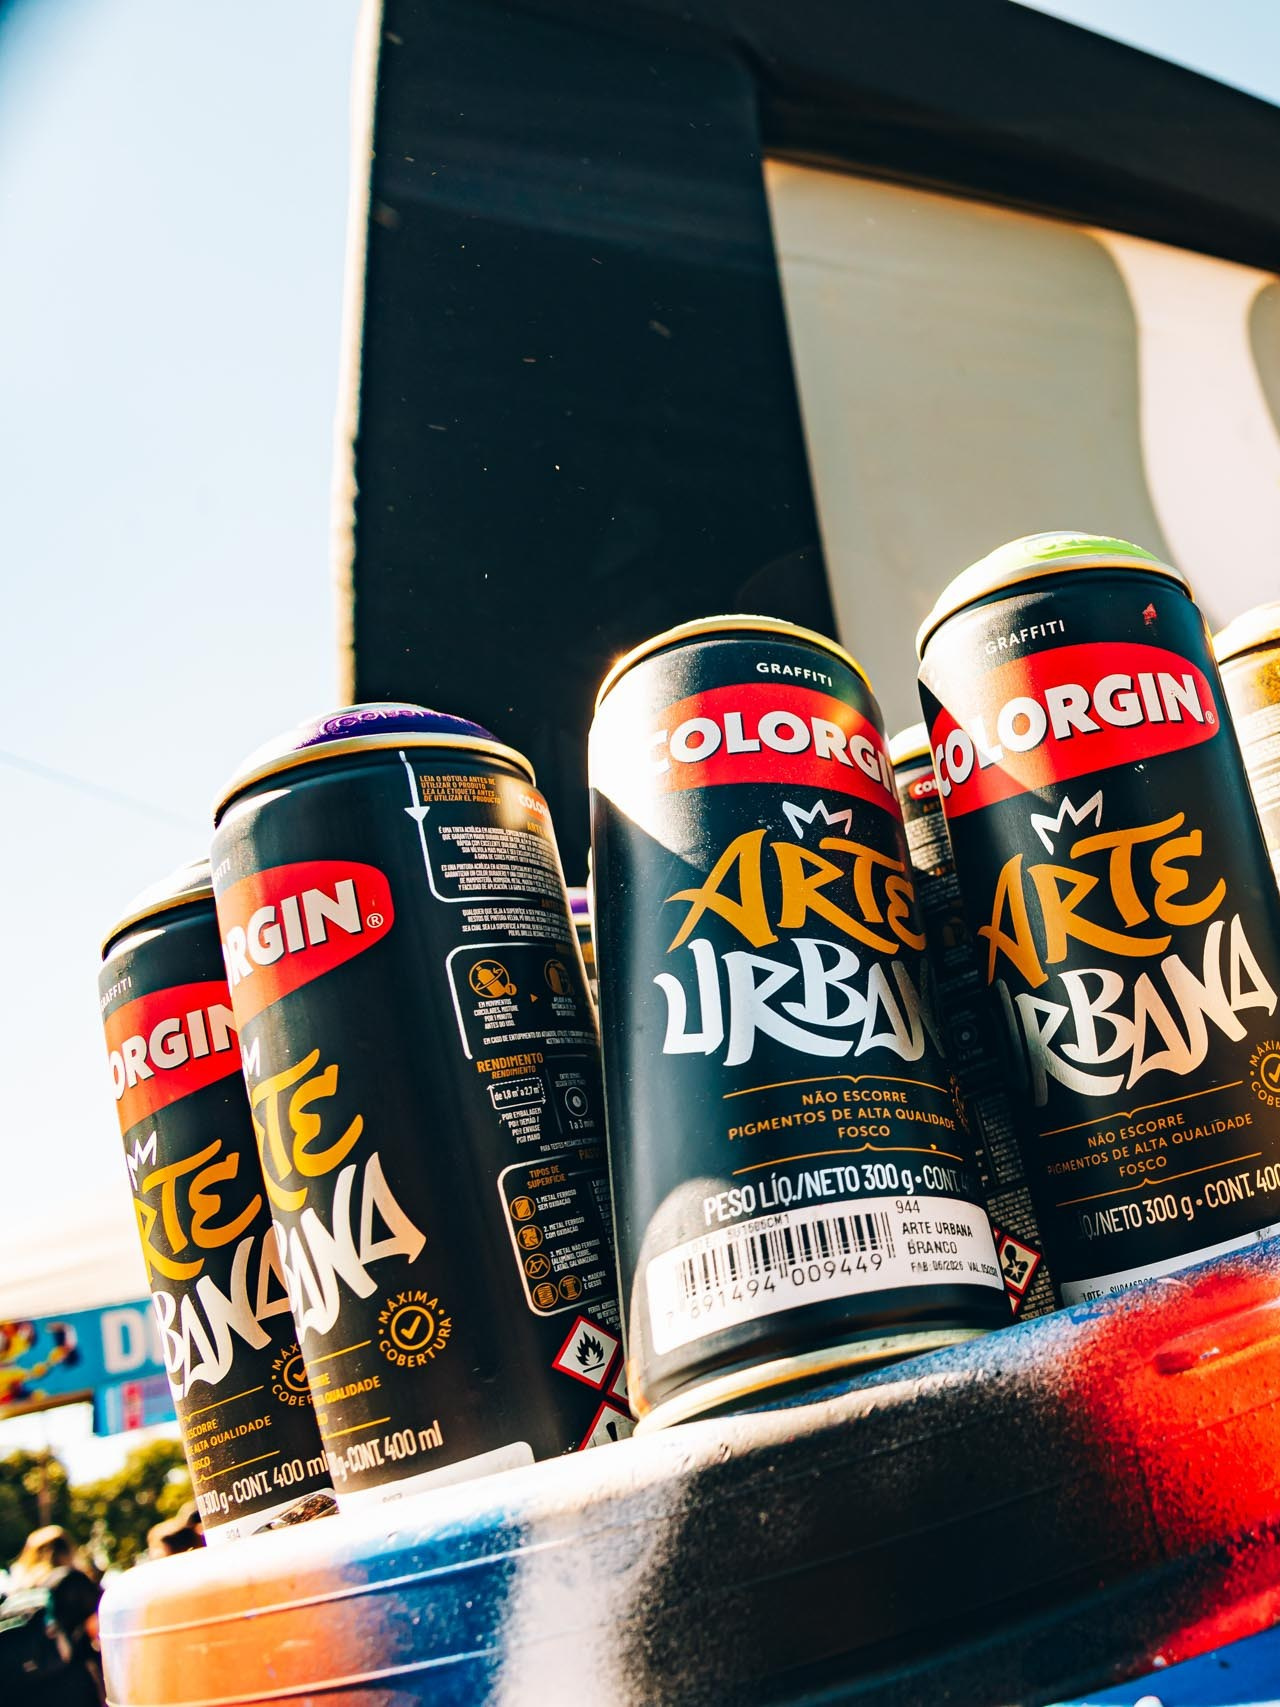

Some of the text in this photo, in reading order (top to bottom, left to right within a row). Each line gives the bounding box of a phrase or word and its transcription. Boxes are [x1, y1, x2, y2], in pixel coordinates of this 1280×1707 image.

[985, 619, 1065, 656] GRAFFITI
[756, 661, 833, 688] GRAFFITI
[934, 672, 1205, 797] COLORGIN
[650, 710, 898, 798] COLORGI
[664, 829, 927, 955] ARTE
[977, 811, 1226, 989] ARTE
[223, 878, 362, 993] RGIN
[1002, 913, 1279, 1105] RBANA
[476, 1052, 544, 1073] RENDIMENTO
[491, 1065, 537, 1080] RENDIMIENTO
[494, 1091, 503, 1101] de
[520, 1089, 525, 1097] a
[802, 1090, 908, 1106] NÃO ESCORRE
[728, 1107, 956, 1141] PIGMENTOS DE ALTA QUALIDADE
[838, 1125, 890, 1139] FOSCO
[1088, 1114, 1185, 1148] NÃO ESCORRE
[1112, 1148, 1130, 1161] DE
[1135, 1137, 1168, 1156] ALTA
[1171, 1113, 1253, 1146] QUALIDADE
[529, 1164, 560, 1178] TIPOS DE
[1119, 1155, 1167, 1178] FOSCO
[703, 1184, 756, 1226] PESO
[760, 1165, 860, 1210] LÍQ./NETO
[864, 1163, 899, 1190] 300
[901, 1170, 914, 1194] g
[922, 1165, 960, 1193] CONT.
[895, 1200, 920, 1214] 944
[1081, 1203, 1143, 1241] Q./NETO
[1142, 1195, 1180, 1225] 300
[1182, 1195, 1195, 1221] g
[1204, 1173, 1255, 1209] CONT.
[902, 1222, 973, 1238] ARTE URBANA
[907, 1239, 958, 1255] BRANCO
[791, 1253, 883, 1287] 009449
[378, 1290, 439, 1325] MÁXIMA
[379, 1316, 453, 1368] COBERTURA
[325, 1375, 382, 1404] QUALIDADE
[210, 1415, 273, 1447] QUALIDADE
[347, 1438, 385, 1473] CONT.
[385, 1428, 417, 1461] 400
[419, 1419, 443, 1453] ml
[220, 1491, 230, 1515] g
[232, 1470, 273, 1504] CONT.
[273, 1459, 305, 1488] 400
[307, 1449, 329, 1477] ml
